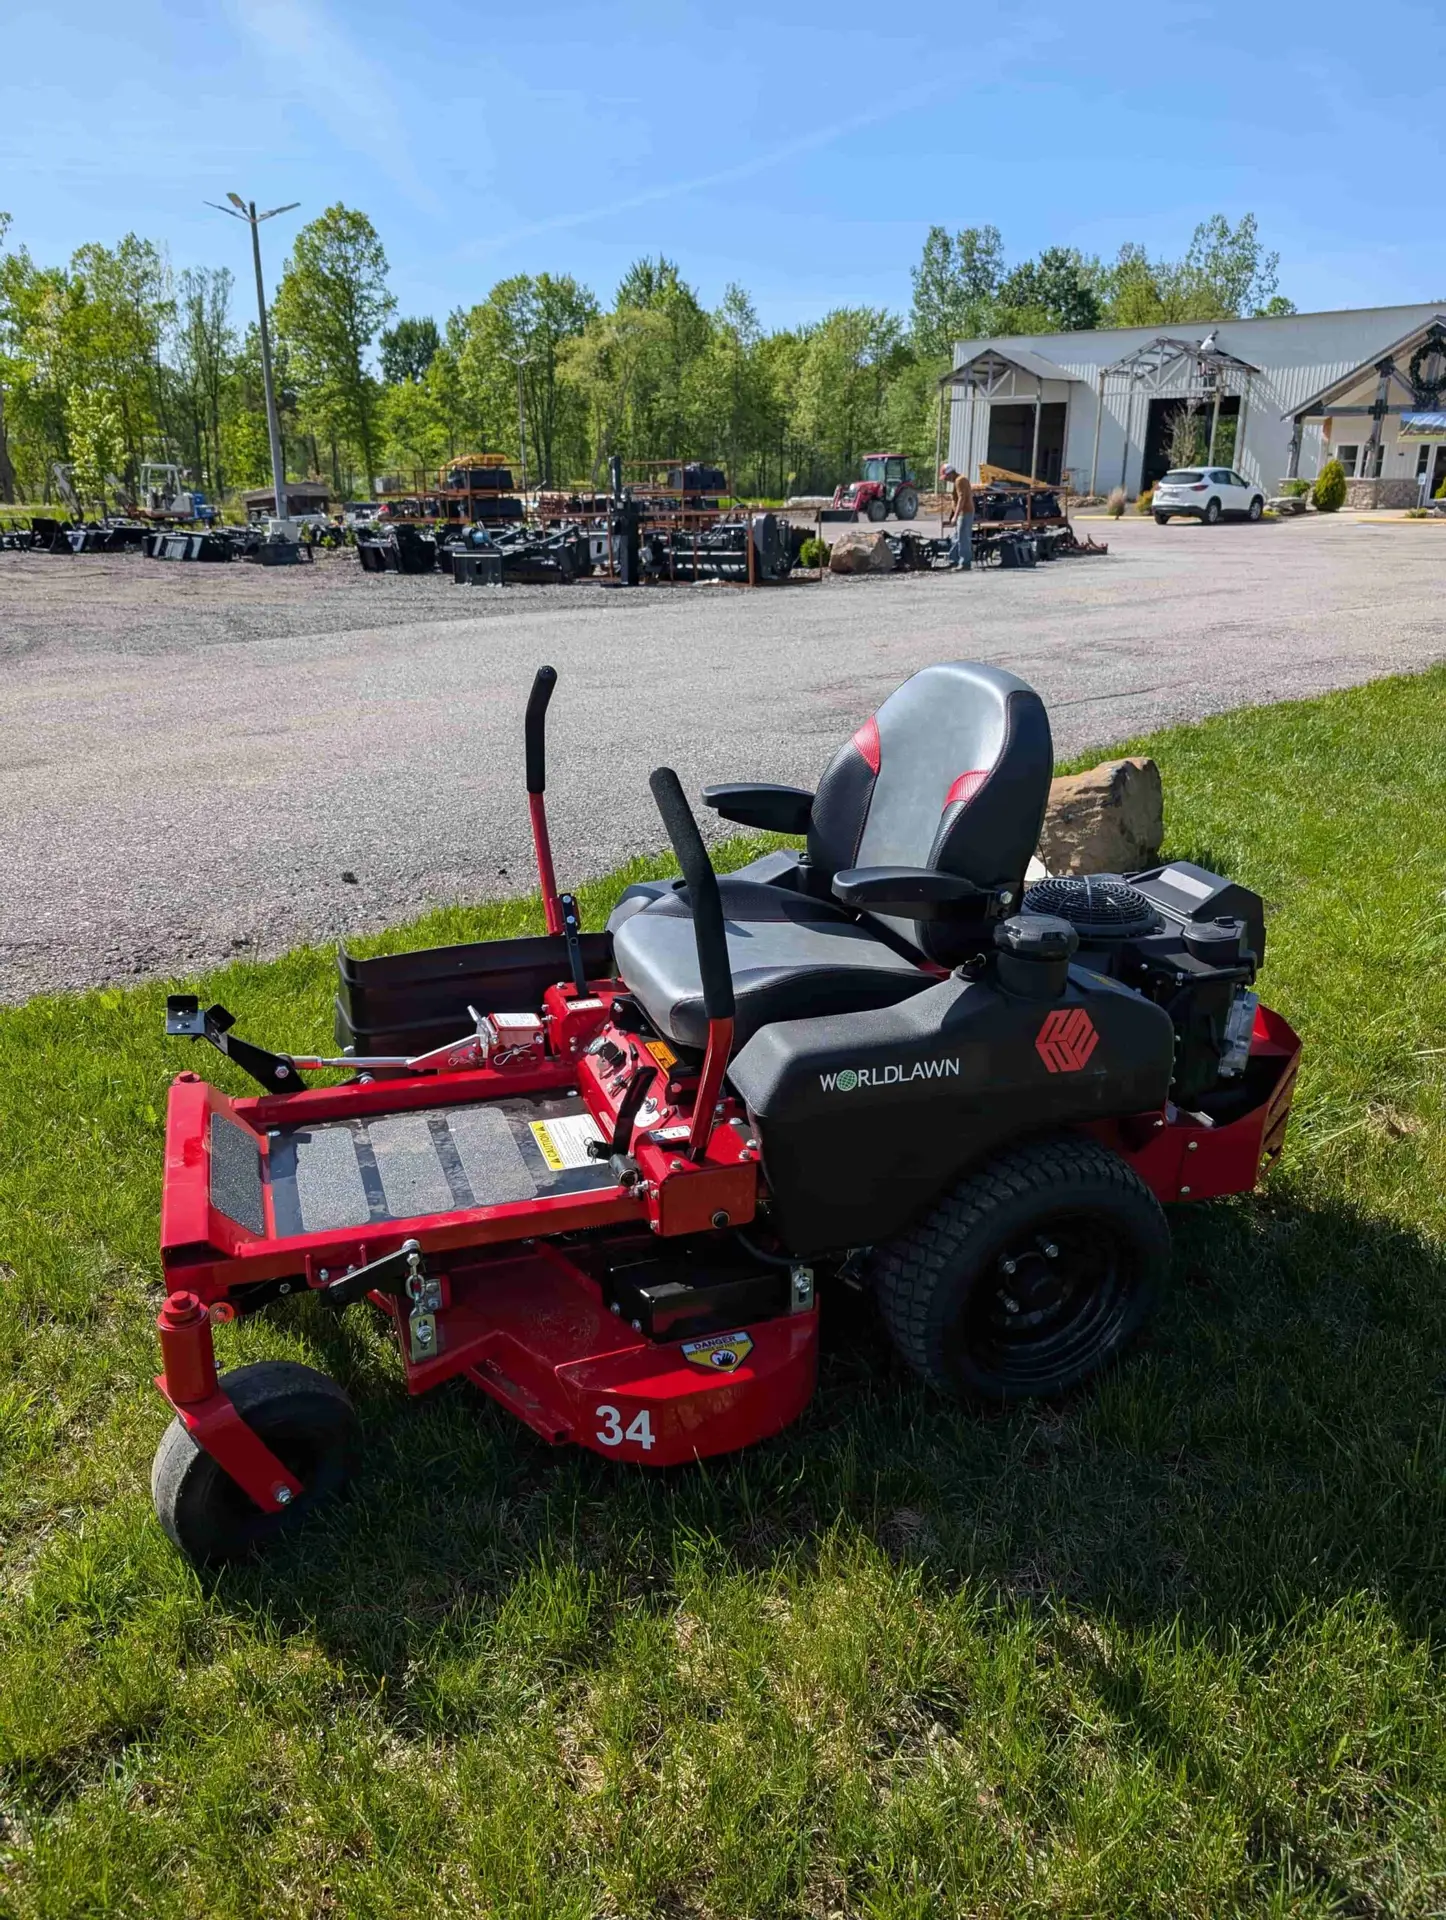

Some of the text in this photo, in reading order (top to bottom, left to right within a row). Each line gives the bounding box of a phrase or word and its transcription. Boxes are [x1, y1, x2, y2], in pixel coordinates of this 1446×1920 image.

[819, 1058, 960, 1092] WORLDLAWN
[540, 1133, 557, 1158] CAUTION
[694, 1335, 736, 1350] DANGER
[596, 1405, 656, 1450] 34
